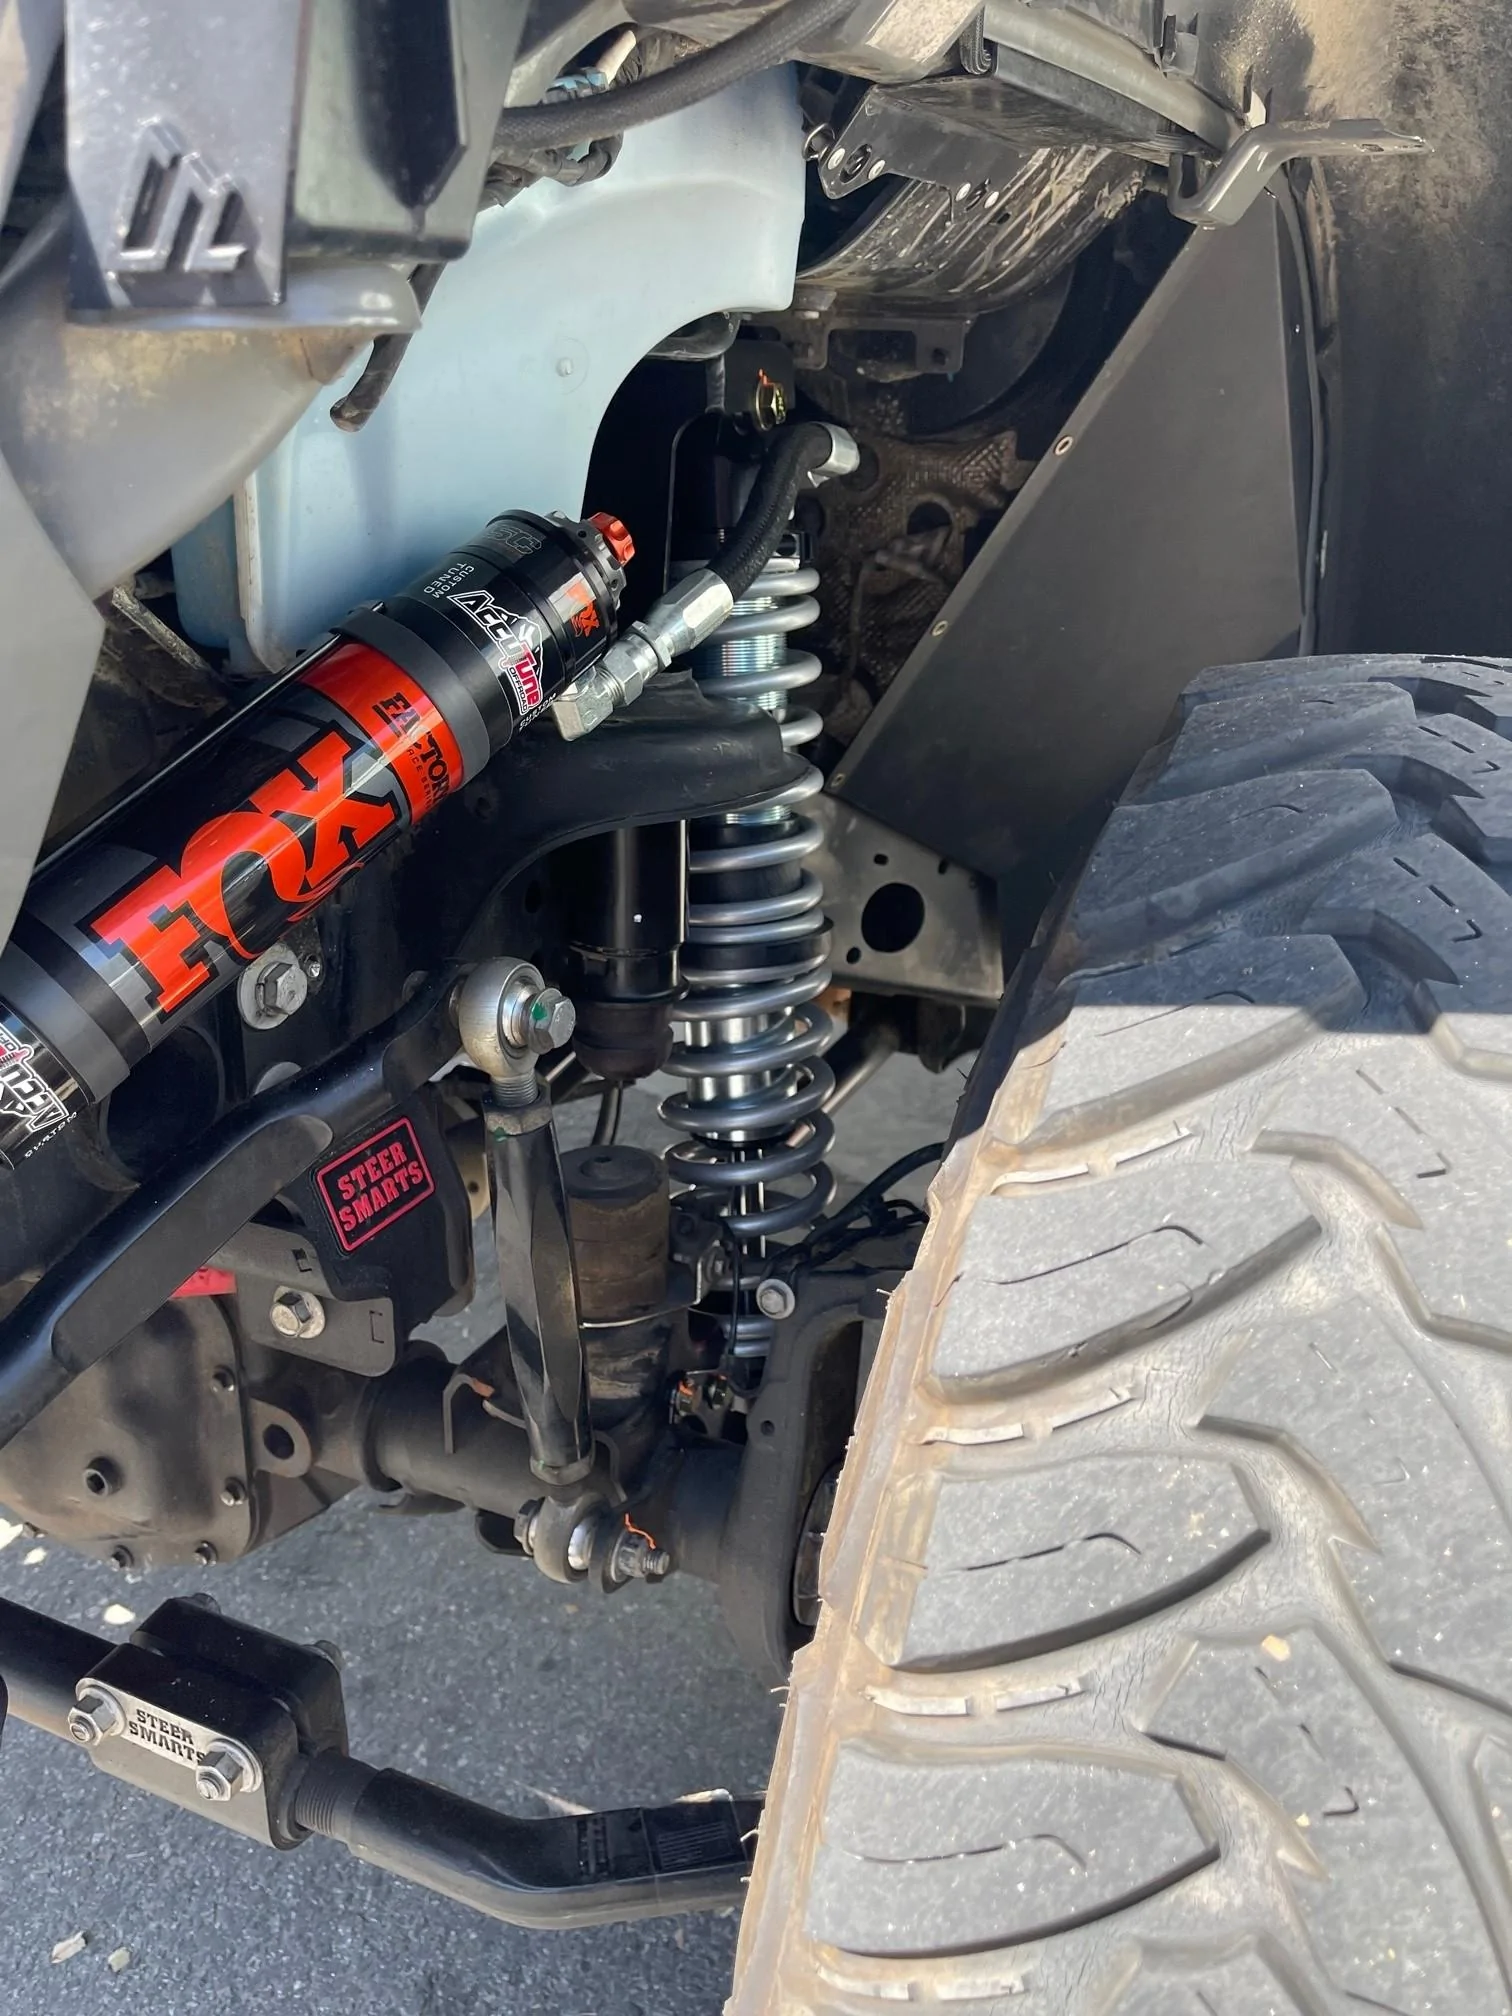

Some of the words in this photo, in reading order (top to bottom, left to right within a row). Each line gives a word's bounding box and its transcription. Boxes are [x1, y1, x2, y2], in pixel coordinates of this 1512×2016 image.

[423, 562, 464, 595] TUNED
[433, 565, 475, 599] CUSTOM
[508, 667, 529, 711] OFFROAD
[406, 746, 423, 771] ACE
[91, 731, 400, 1014] FOX
[337, 1141, 408, 1201] STEER
[338, 1160, 424, 1232] SMARTS
[136, 1708, 194, 1746] STEER
